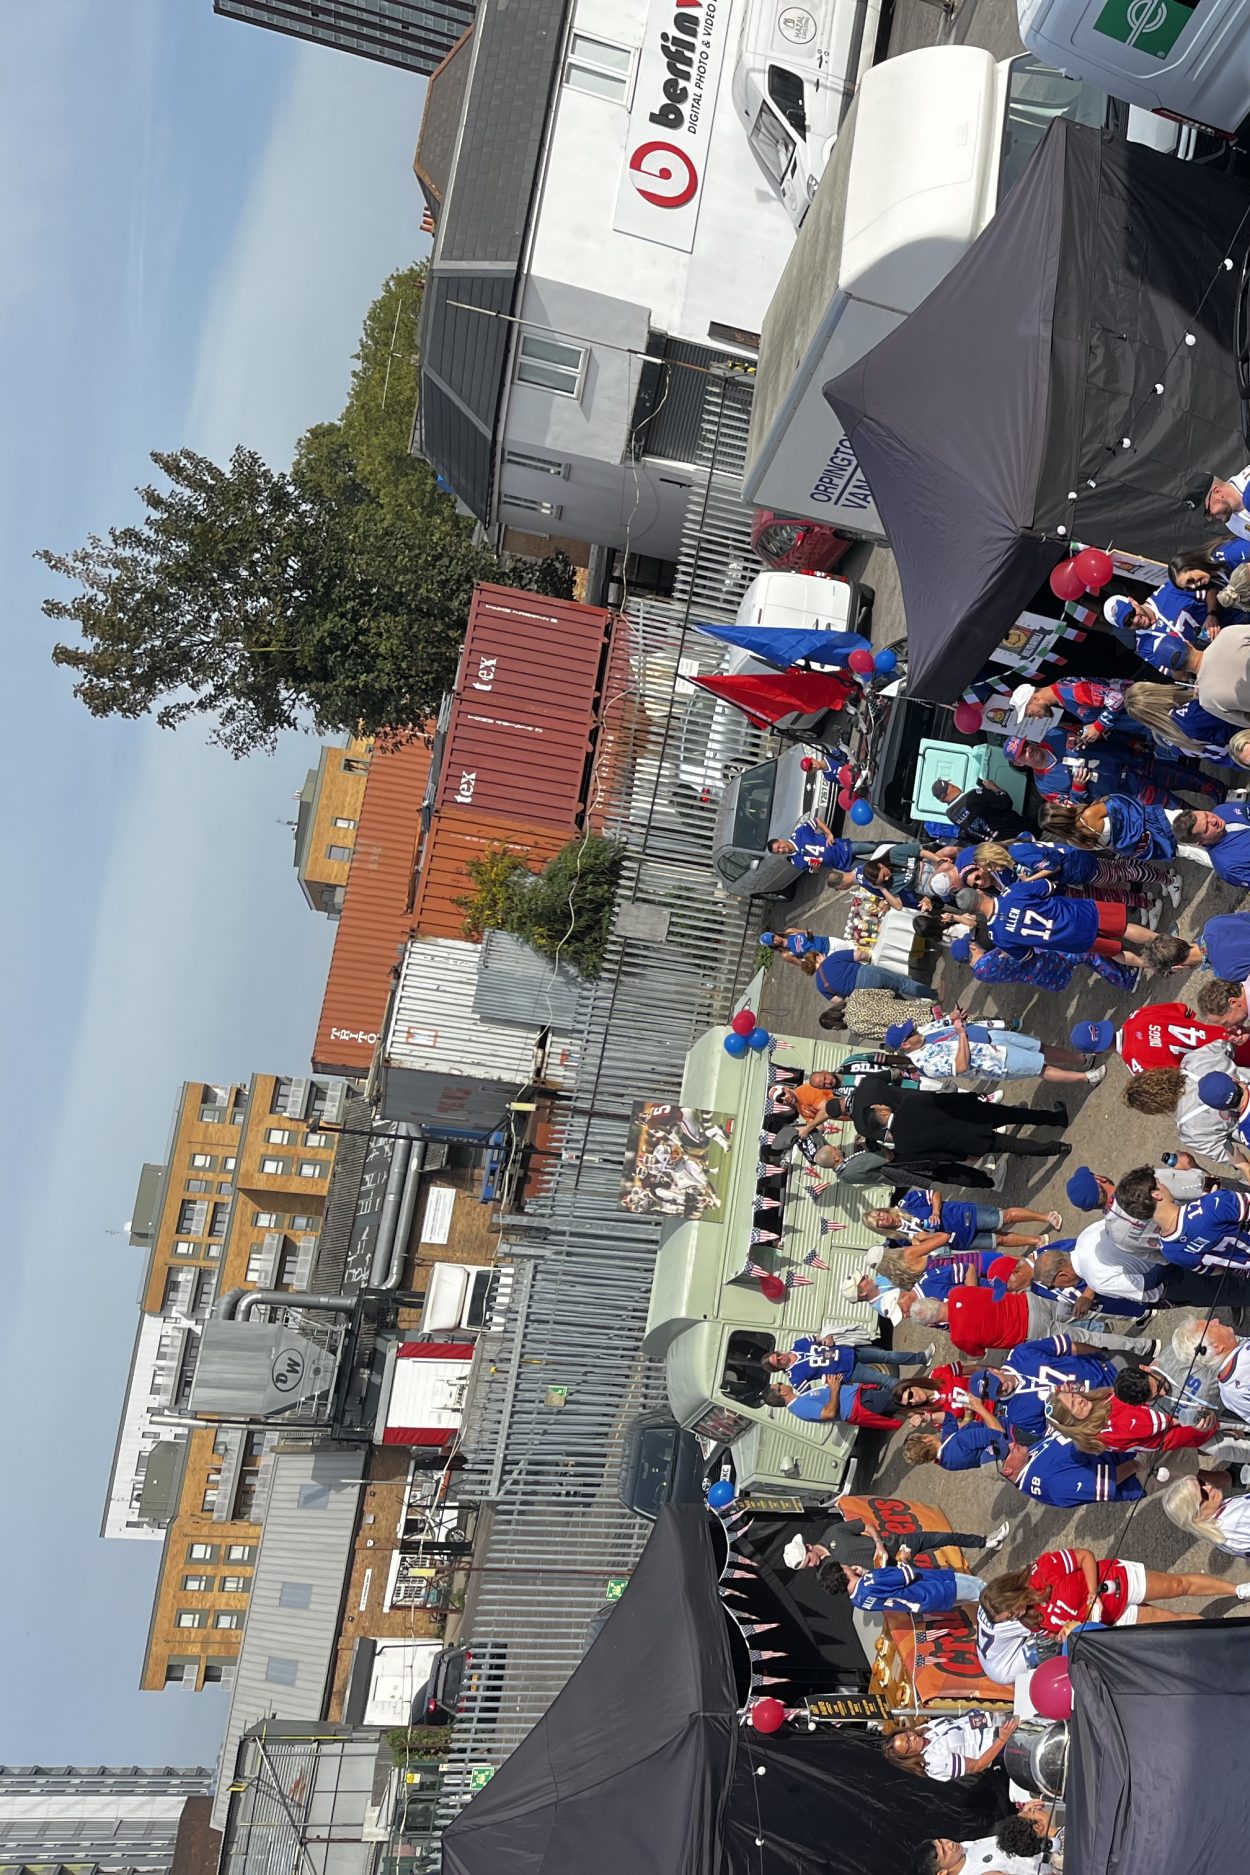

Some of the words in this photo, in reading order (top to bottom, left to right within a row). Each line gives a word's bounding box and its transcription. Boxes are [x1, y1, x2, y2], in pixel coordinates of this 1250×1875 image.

[703, 4, 717, 36] VIDEO
[794, 16, 805, 38] HAZAL
[702, 39, 711, 49] &
[648, 11, 700, 130] berfin
[695, 51, 709, 90] PHOTO
[687, 93, 703, 134] DIGITAL
[809, 433, 856, 503] ORPINGTO
[472, 657, 498, 692] tex
[454, 770, 476, 803] tex
[820, 787, 829, 804] Y267
[803, 843, 825, 863] 14
[1004, 907, 1021, 932] ALLEN
[1020, 909, 1054, 940] 17
[330, 1028, 380, 1044] TRITO
[1148, 1023, 1162, 1047] DIGGS
[1167, 1023, 1206, 1055] 14
[652, 1104, 672, 1116] 5
[1187, 1199, 1203, 1220] 17
[1030, 1476, 1042, 1496] 58
